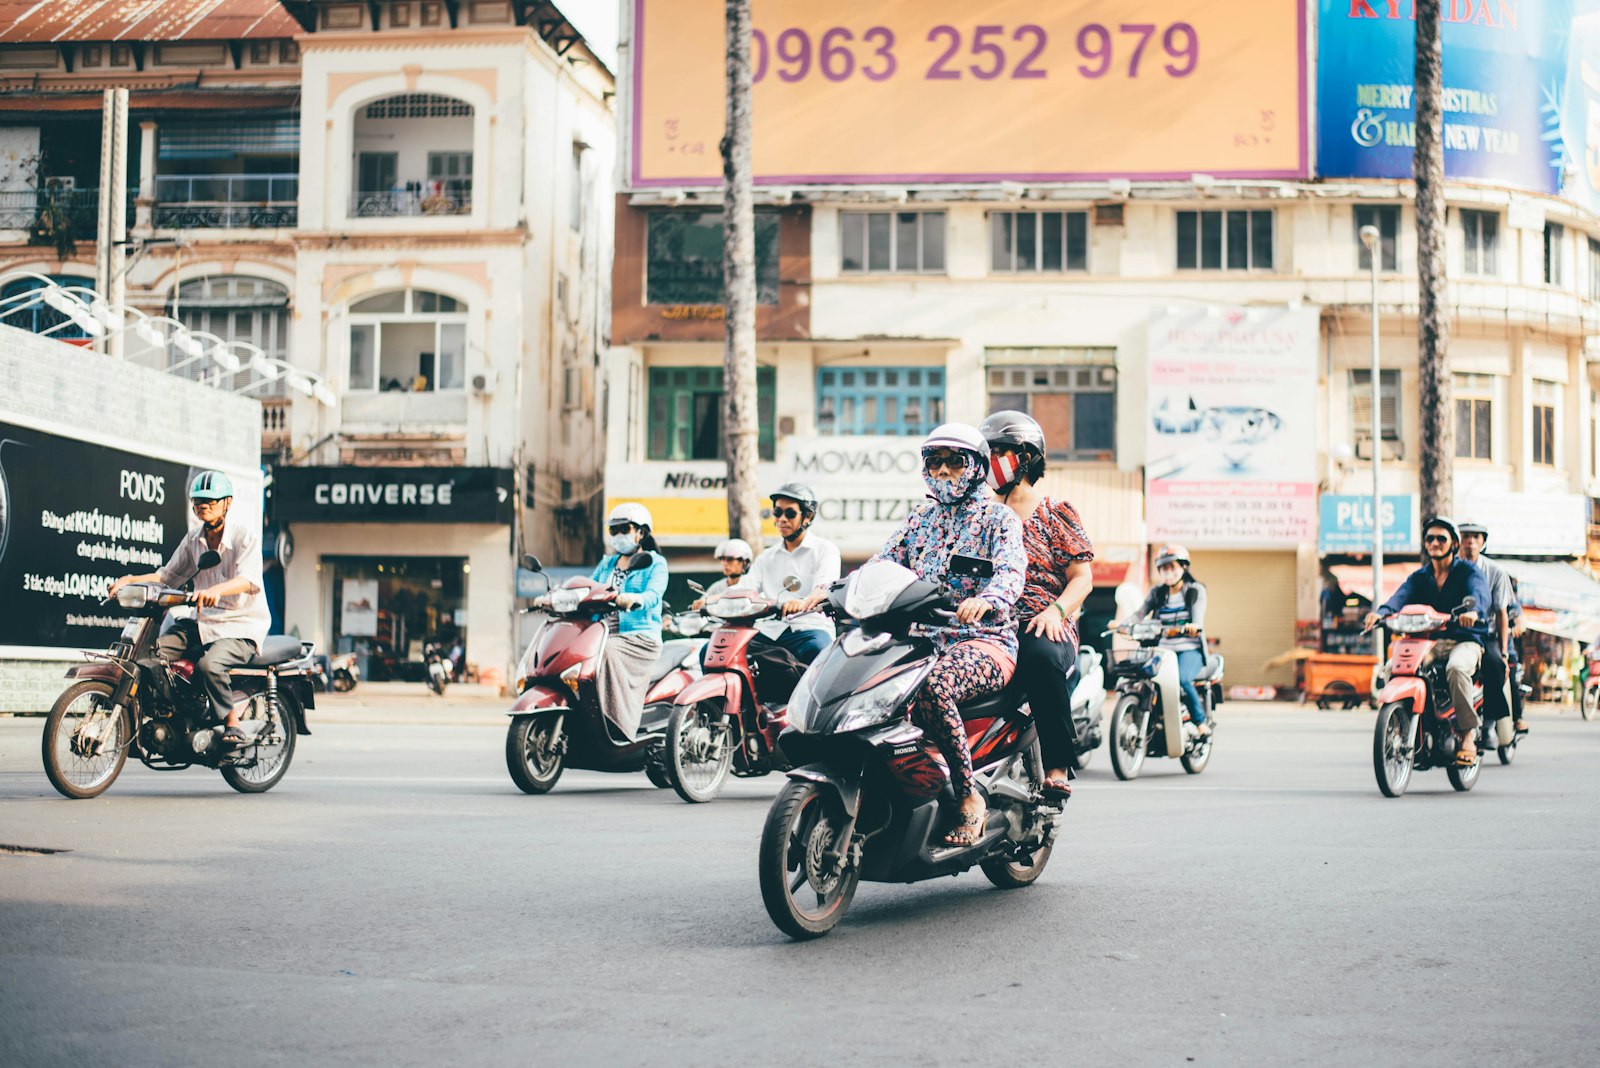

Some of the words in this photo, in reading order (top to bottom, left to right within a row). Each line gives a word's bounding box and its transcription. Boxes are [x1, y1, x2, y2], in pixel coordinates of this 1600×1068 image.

[924, 25, 1048, 80] 252
[1075, 22, 1200, 80] 979
[1356, 84, 1413, 110] MERRY
[1351, 108, 1387, 147] &
[1444, 124, 1480, 151] NEW
[1482, 127, 1519, 156] YEAR
[794, 451, 918, 473] MOVADO
[664, 471, 728, 489] Nikon
[315, 483, 452, 505] CONVERSE
[23, 573, 30, 590] 3
[894, 746, 917, 755] HONDA
